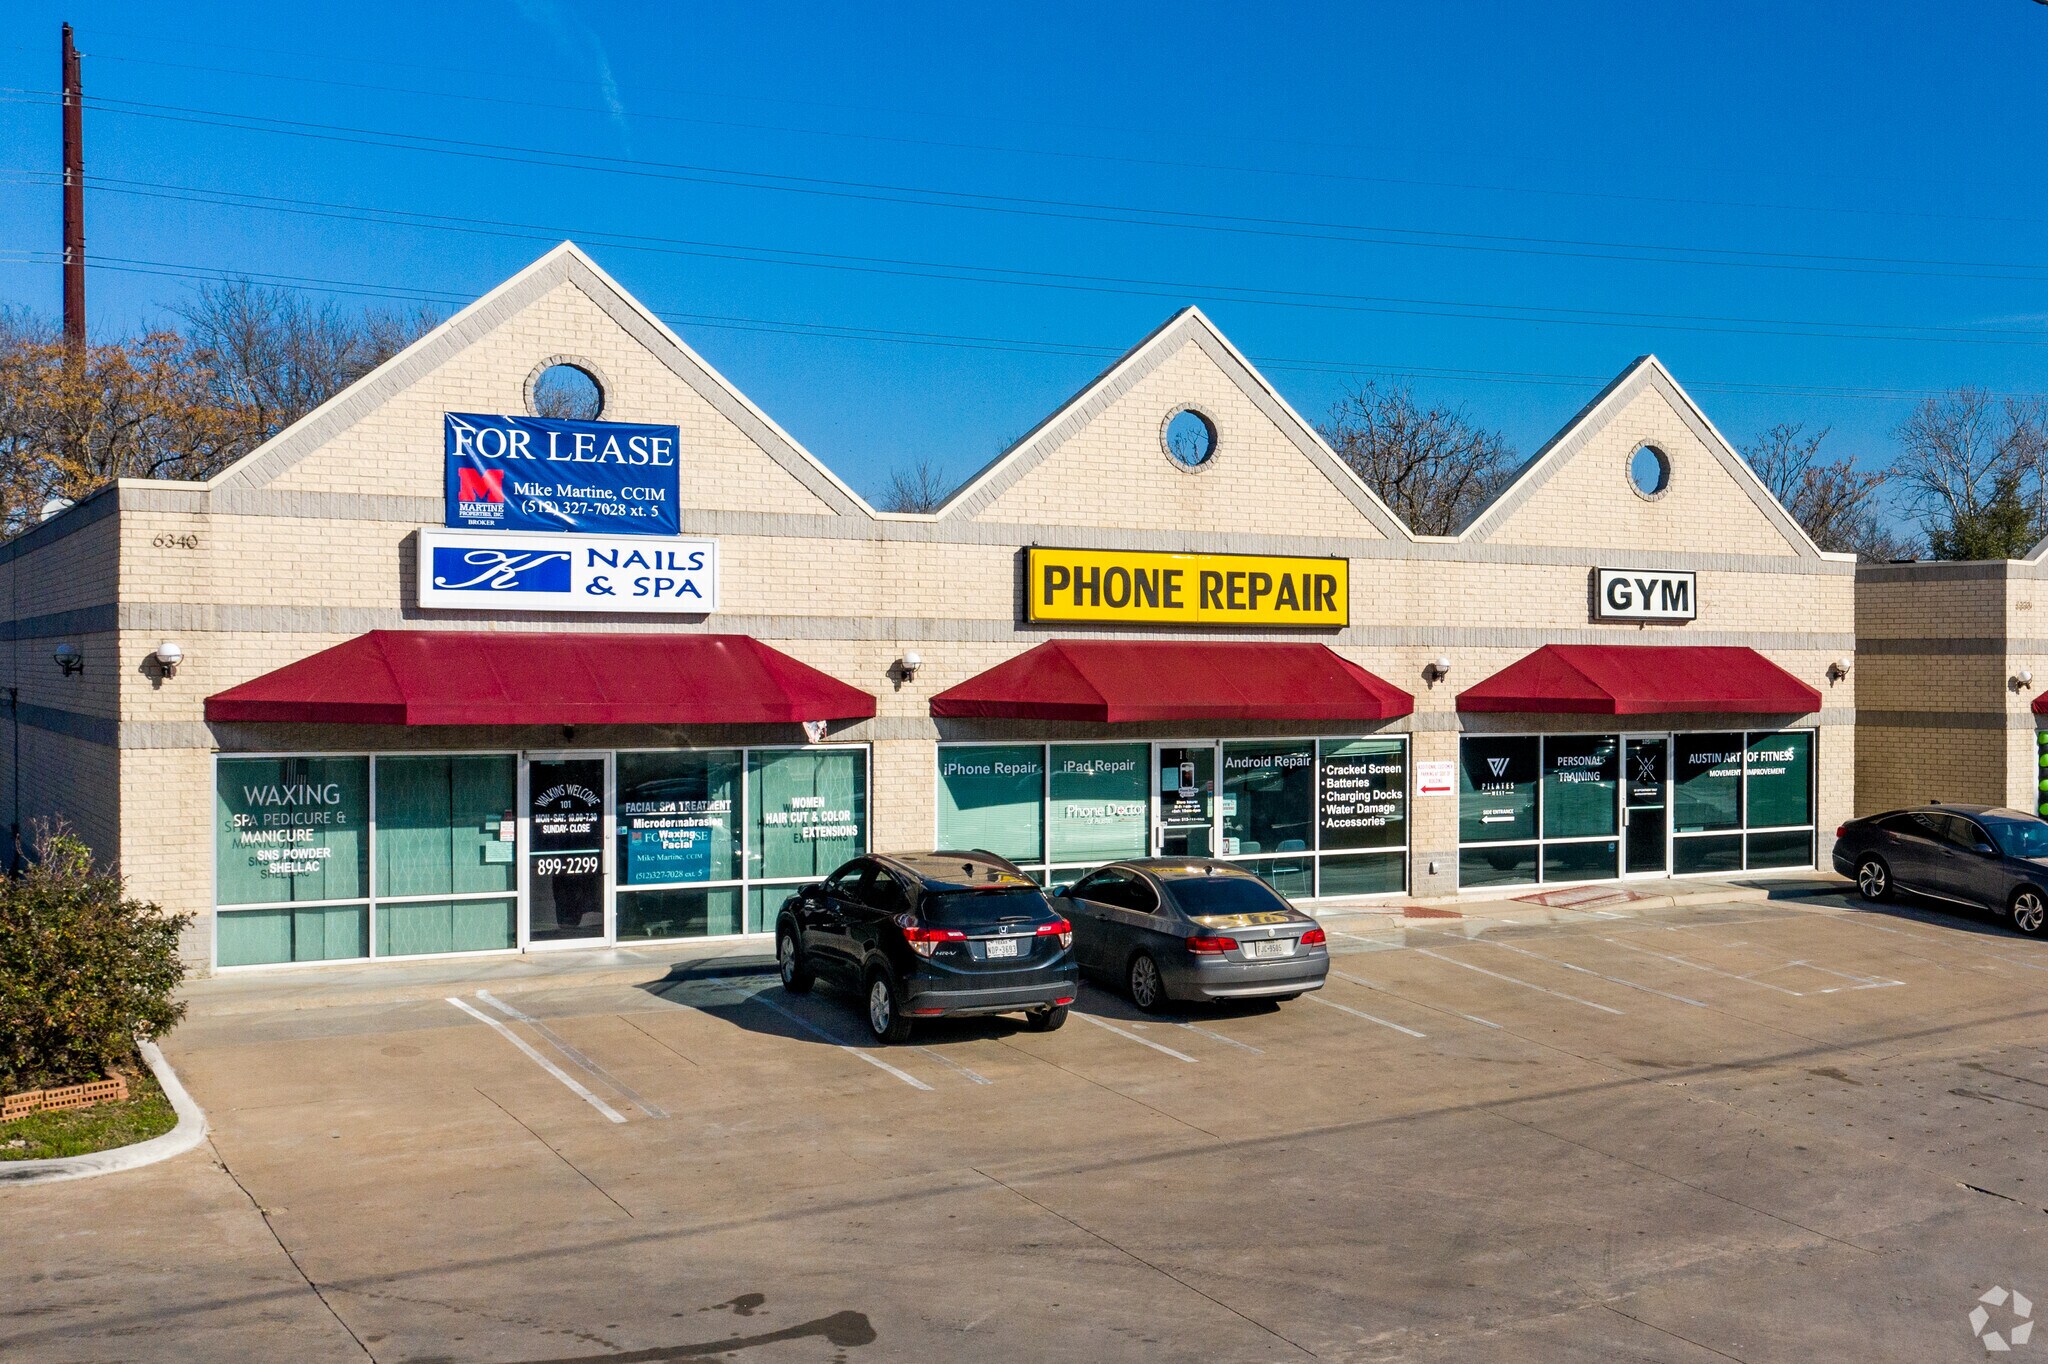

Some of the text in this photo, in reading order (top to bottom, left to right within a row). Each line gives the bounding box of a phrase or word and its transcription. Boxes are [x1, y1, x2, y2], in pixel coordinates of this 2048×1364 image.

[452, 425, 674, 467] FOR LEASE
[514, 481, 666, 502] Mike Martine, CCIM
[459, 503, 504, 512] MARTINE
[522, 500, 658, 517] (512) 327-7028 xt. 5
[152, 533, 198, 549] 6340
[587, 548, 705, 571] NAILS
[586, 576, 703, 599] & SPA
[1043, 564, 1338, 612] PHONE REPAIR
[1607, 577, 1689, 611] GYM
[1225, 755, 1311, 769] Android Repair
[1557, 756, 1601, 766] PERSONAL
[1689, 751, 1794, 764] AUSTIN ART OF FITNESS
[944, 762, 1037, 776] iPhone Repair
[1064, 759, 1135, 773] iPad Repair
[1326, 763, 1401, 775] Cracked Screen
[1709, 768, 1786, 777] MOVEMENT IMPROVEMENT
[1558, 771, 1600, 782] TRAINING
[1326, 778, 1370, 789] Batteries
[1482, 782, 1514, 790] PILATES
[243, 783, 340, 806] WAXING
[535, 784, 600, 807] WALKINS WELCOME
[1326, 789, 1403, 803] Charging Docks
[560, 800, 571, 809] 101
[625, 800, 732, 813] FACIAL SPA TREATMENT
[791, 797, 825, 809] WOMEN
[1326, 804, 1395, 815] Water Damage
[1067, 804, 1104, 816] Phone
[233, 811, 346, 827] SPA PEDICURE &
[766, 810, 850, 824] HAIR CUT & COLOR
[1326, 816, 1386, 828] Accessories
[569, 823, 591, 833] CLOSE
[658, 829, 696, 840] Waxing
[802, 825, 858, 838] EXTENSIONS
[241, 829, 314, 843] MANICURE
[662, 840, 692, 849] Facial
[257, 847, 331, 861] SNS POWDER
[637, 854, 655, 862] Mike
[269, 861, 320, 873] SHELLAC
[538, 857, 598, 875] 899-2299
[698, 869, 702, 877] 5
